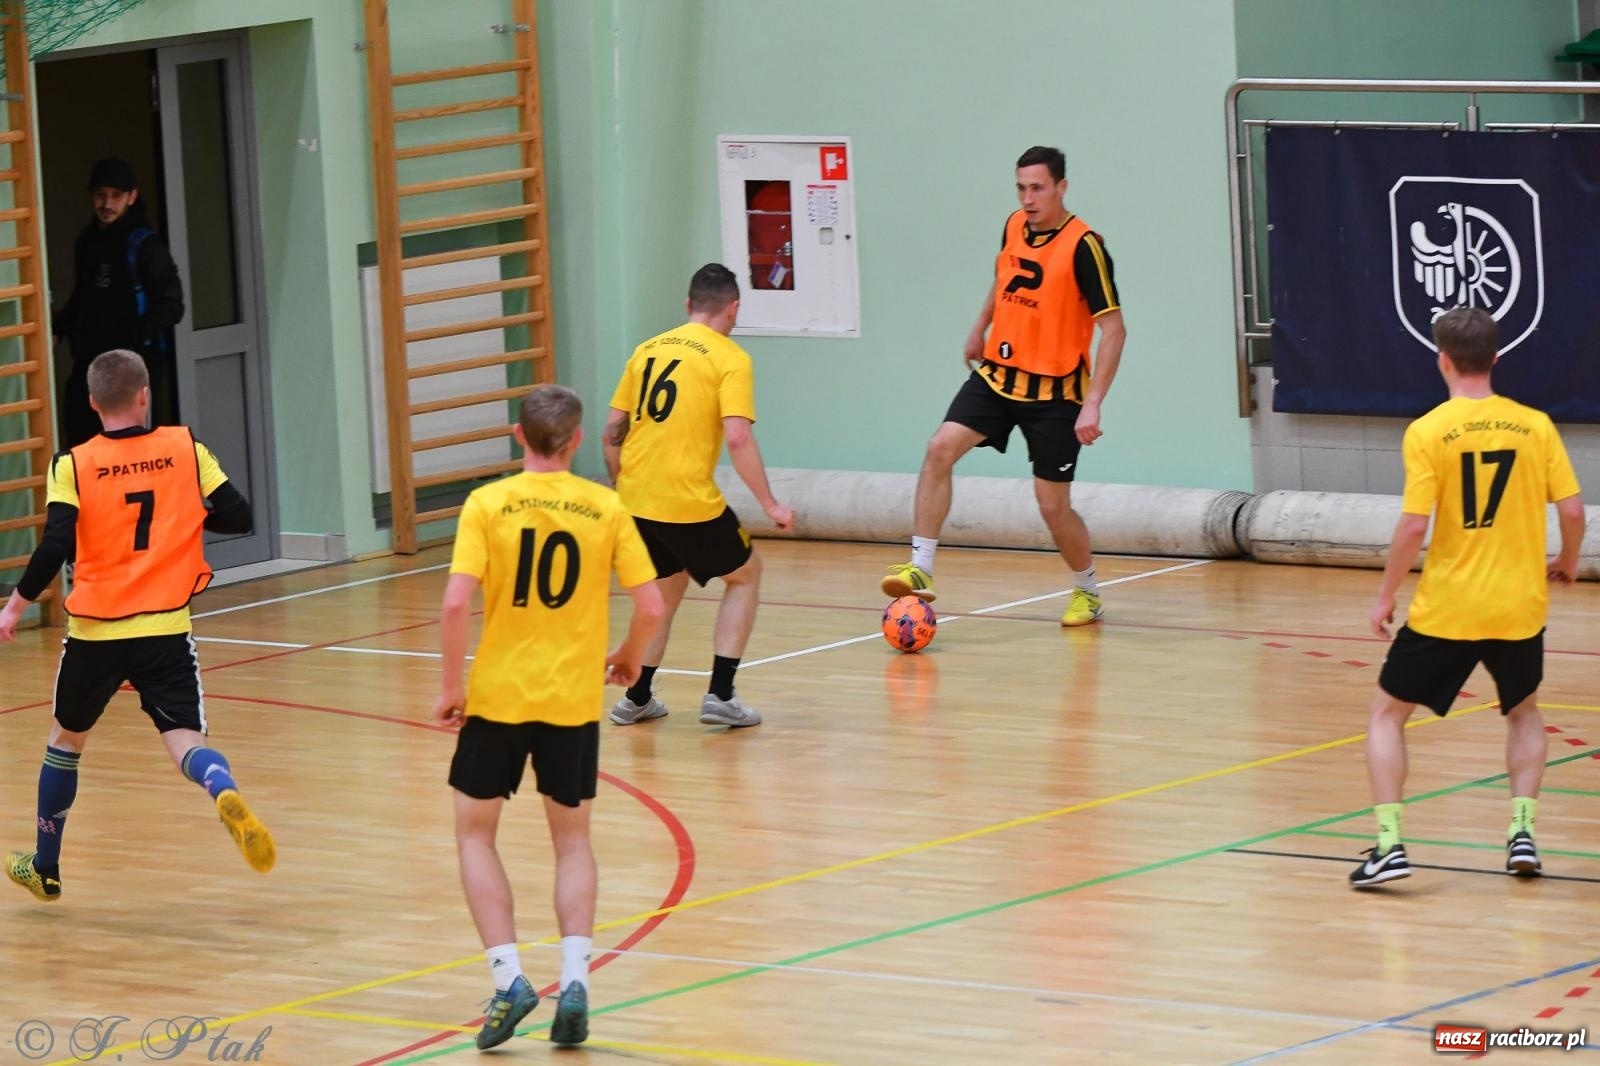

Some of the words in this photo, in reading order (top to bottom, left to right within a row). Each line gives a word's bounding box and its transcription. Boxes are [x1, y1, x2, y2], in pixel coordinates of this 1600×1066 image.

[1002, 292, 1039, 310] PATRICK
[635, 357, 682, 423] 16
[113, 457, 174, 477] PATRICK
[1461, 449, 1516, 529] 17
[125, 489, 155, 551] 7
[512, 528, 580, 609] 10
